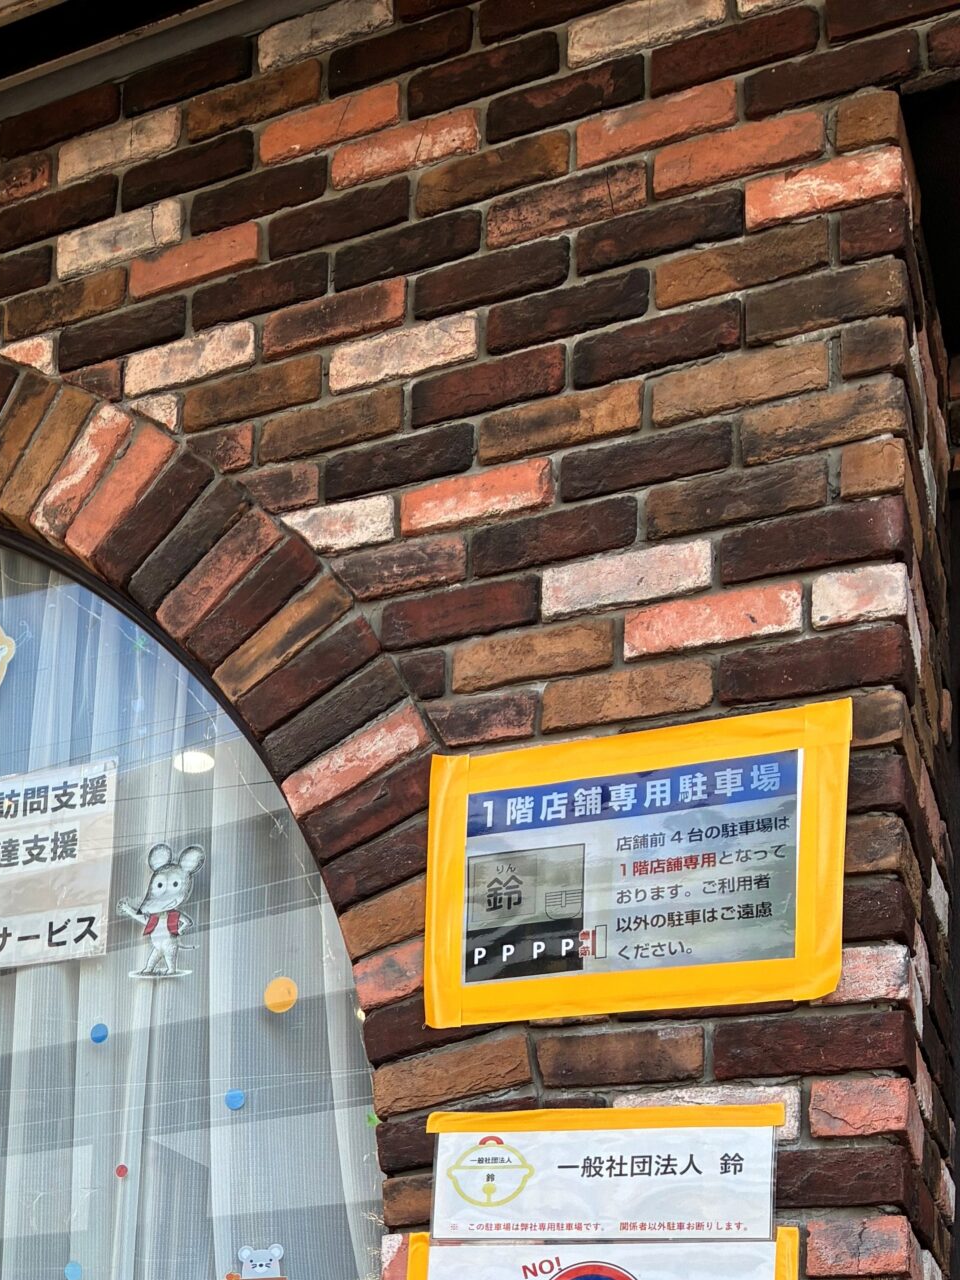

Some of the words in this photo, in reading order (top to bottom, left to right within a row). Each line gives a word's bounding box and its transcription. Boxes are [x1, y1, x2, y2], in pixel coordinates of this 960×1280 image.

[483, 762, 781, 828] 1階店舗専用駐車場
[496, 863, 516, 875] りん
[486, 875, 523, 912] 鈴
[616, 873, 771, 904] おります。ご利用者
[615, 901, 773, 933] 以外の駐車はご遠慮
[474, 947, 487, 965] P
[502, 944, 515, 962] P
[533, 941, 546, 959] P
[561, 938, 574, 957] P
[617, 940, 693, 961] ください。
[470, 1156, 512, 1165] 一般社団法人
[558, 1153, 703, 1178] 一般社団法人
[720, 1152, 745, 1176] 鈴
[485, 1173, 496, 1183] 鈴
[521, 1256, 563, 1280] NO!
